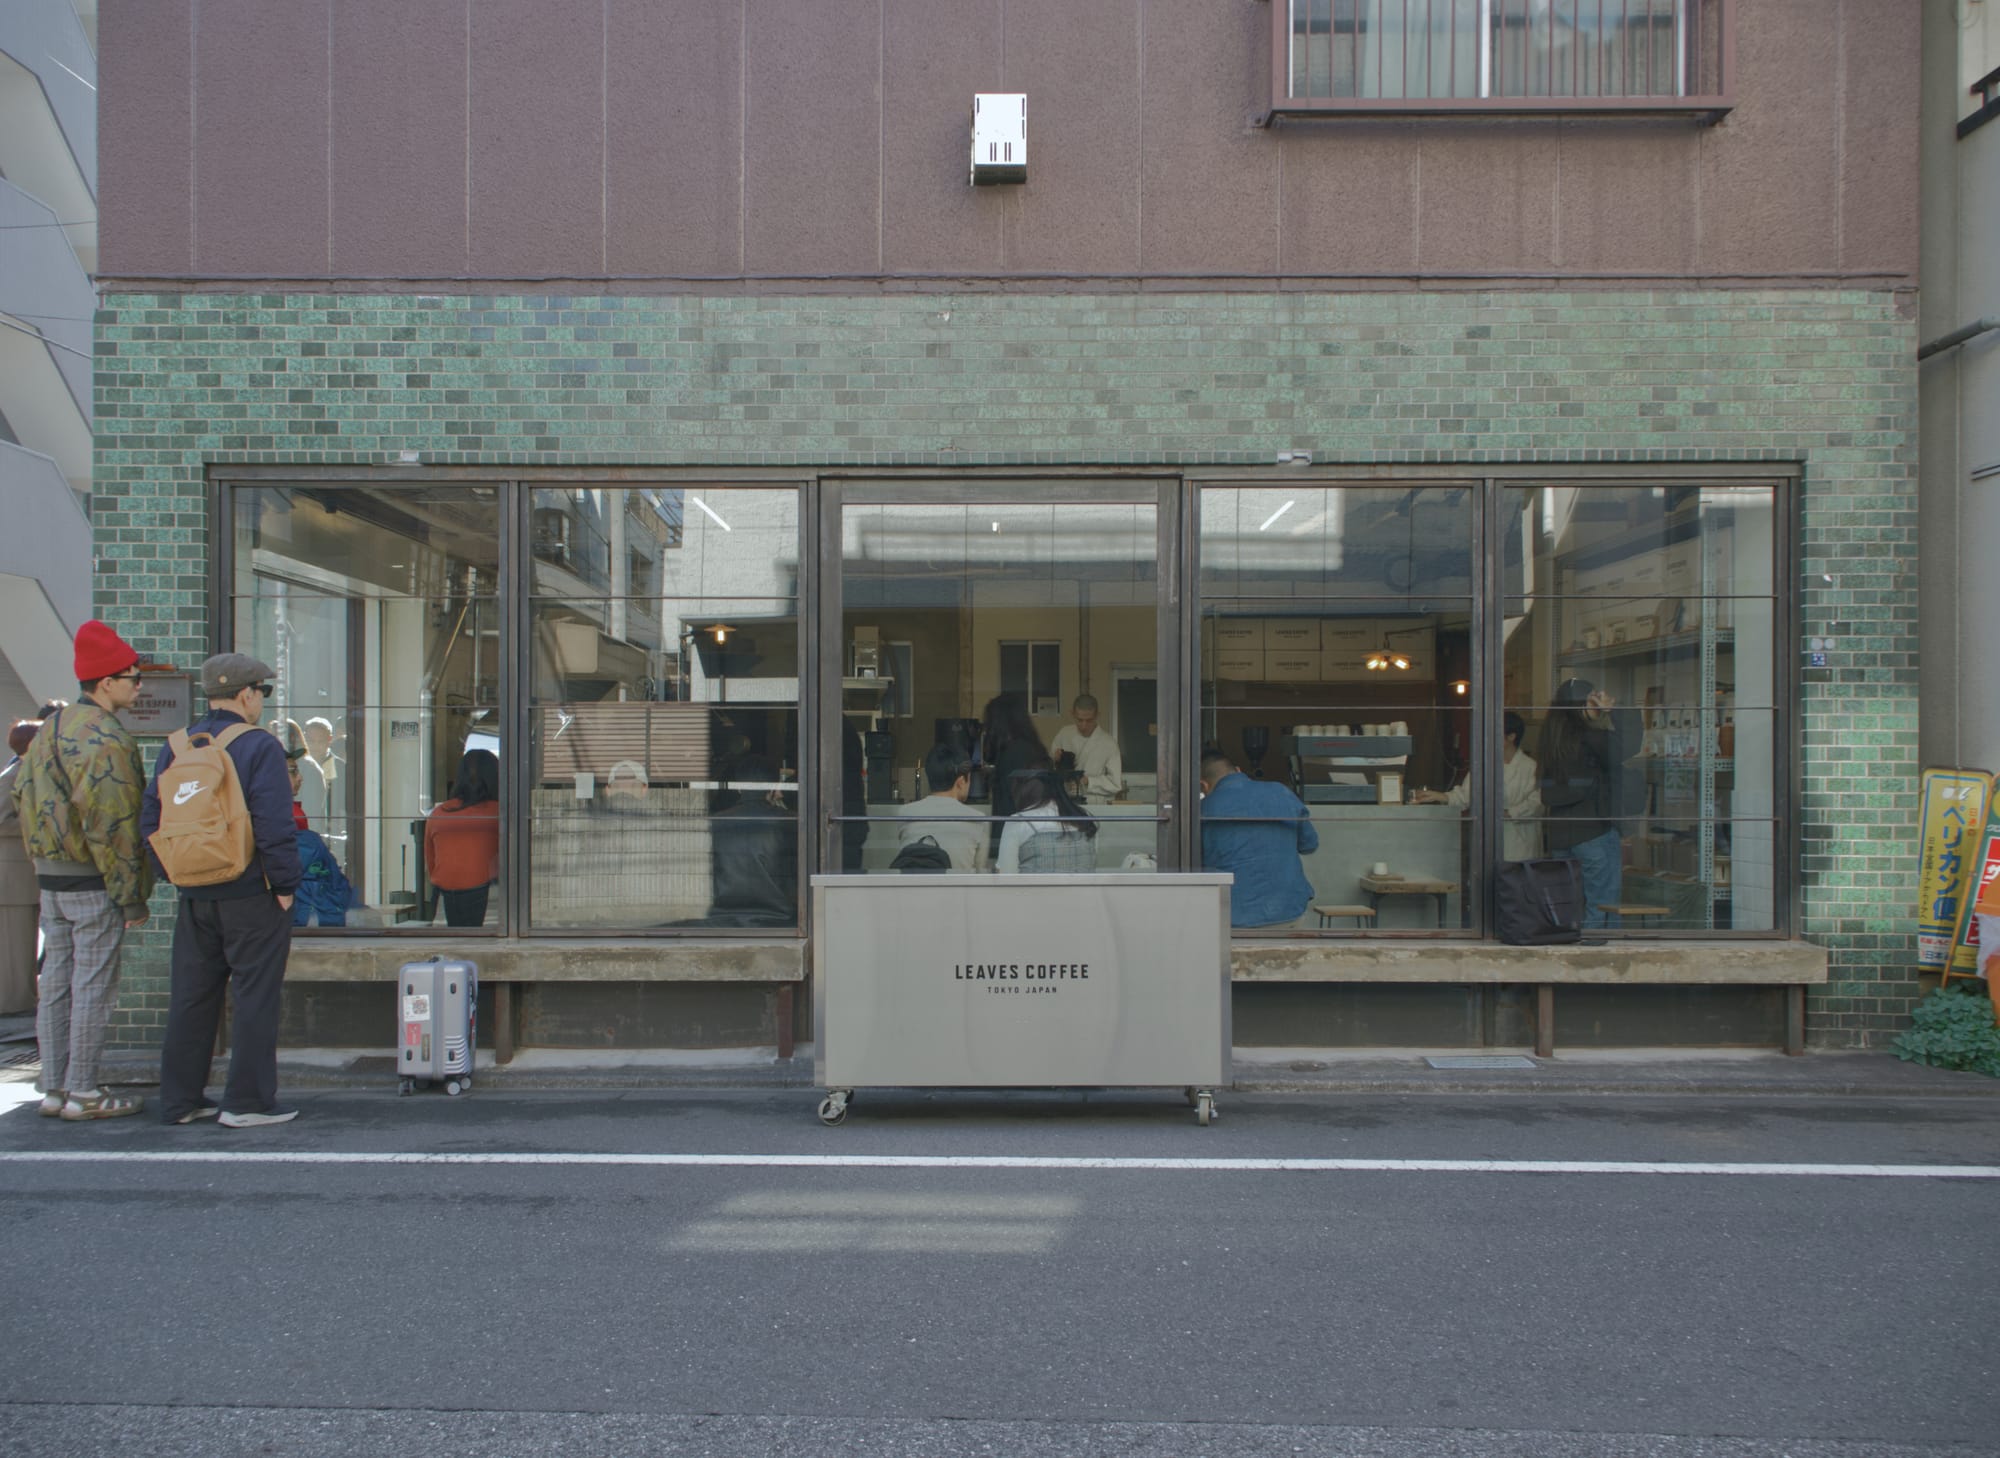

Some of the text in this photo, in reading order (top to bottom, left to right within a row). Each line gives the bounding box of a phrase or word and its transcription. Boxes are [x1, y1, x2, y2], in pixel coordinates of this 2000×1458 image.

[1932, 805, 1966, 922] ペリカン便
[955, 964, 1089, 979] LEAVES COFFEE
[987, 986, 1057, 994] TOKYO JAPAN
